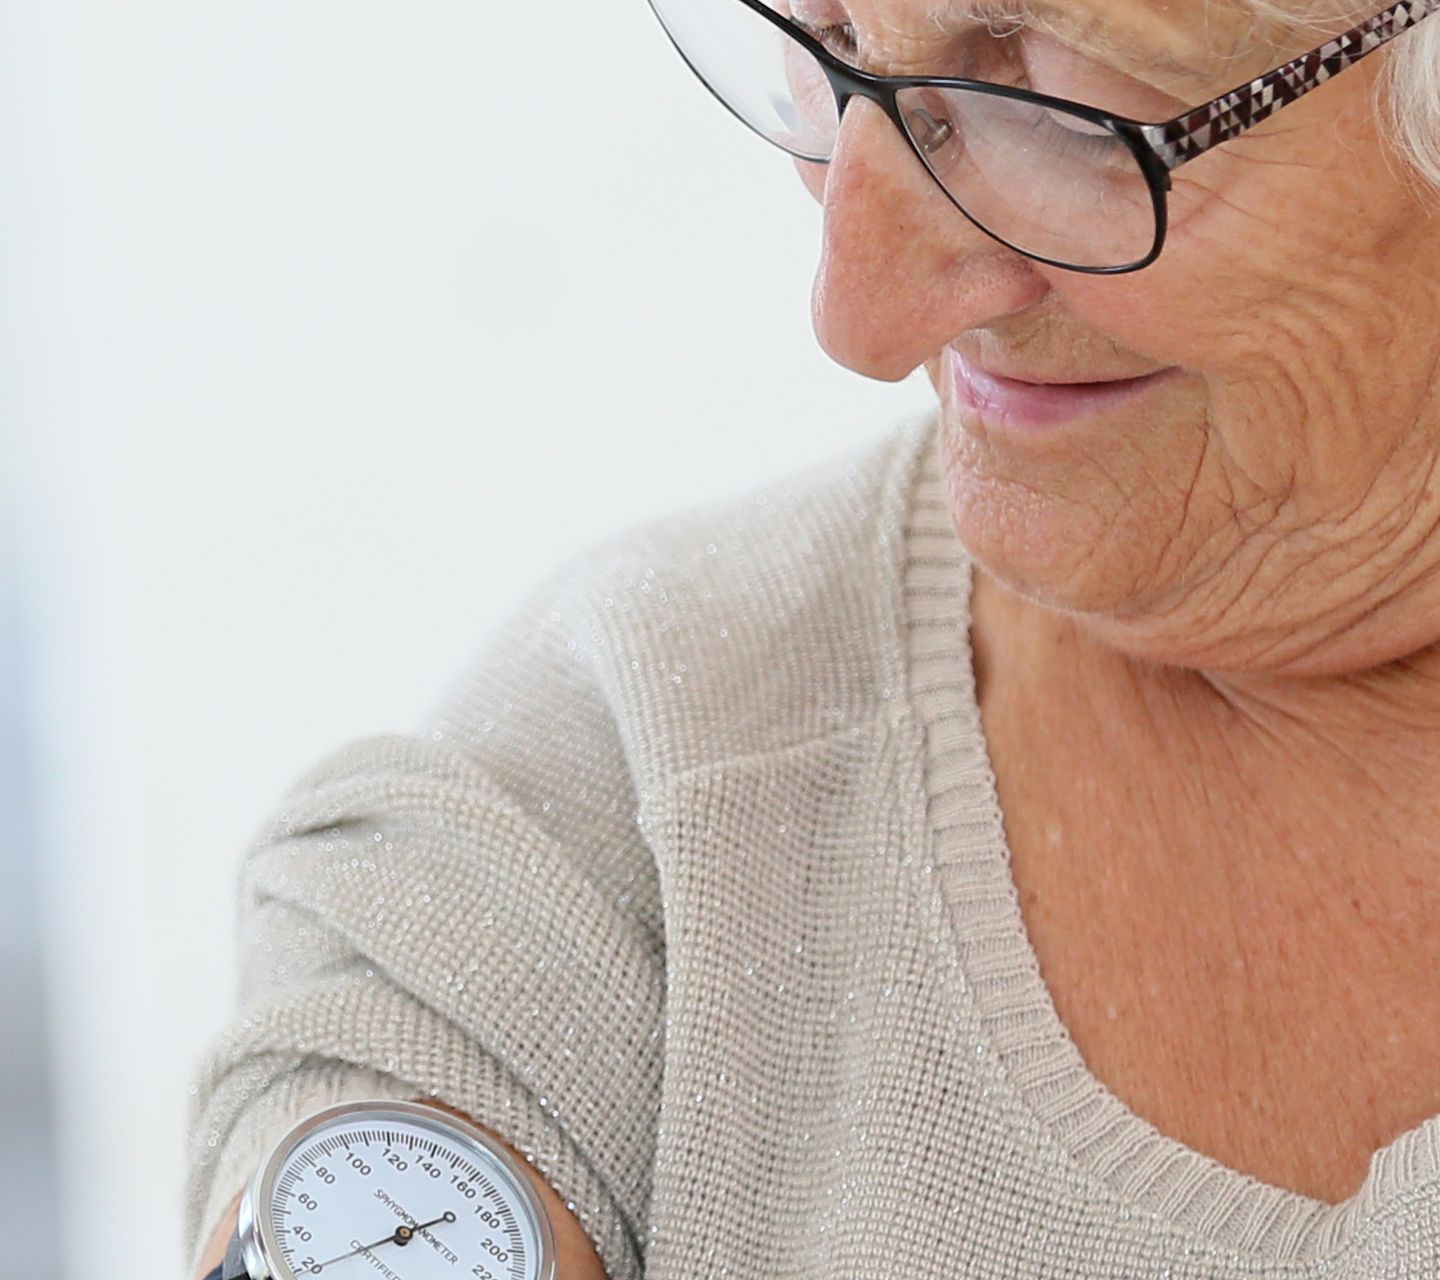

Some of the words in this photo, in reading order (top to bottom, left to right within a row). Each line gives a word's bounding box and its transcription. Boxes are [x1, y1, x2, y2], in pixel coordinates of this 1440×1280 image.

[345, 1152, 371, 1176] 100
[382, 1148, 408, 1172] 120
[415, 1155, 441, 1178] 140
[315, 1166, 336, 1184] 80
[449, 1175, 476, 1199] 160
[298, 1193, 318, 1211] 60
[474, 1205, 500, 1229] 180
[292, 1225, 312, 1242] 40
[481, 1238, 508, 1263] 200
[301, 1256, 322, 1275] 20
